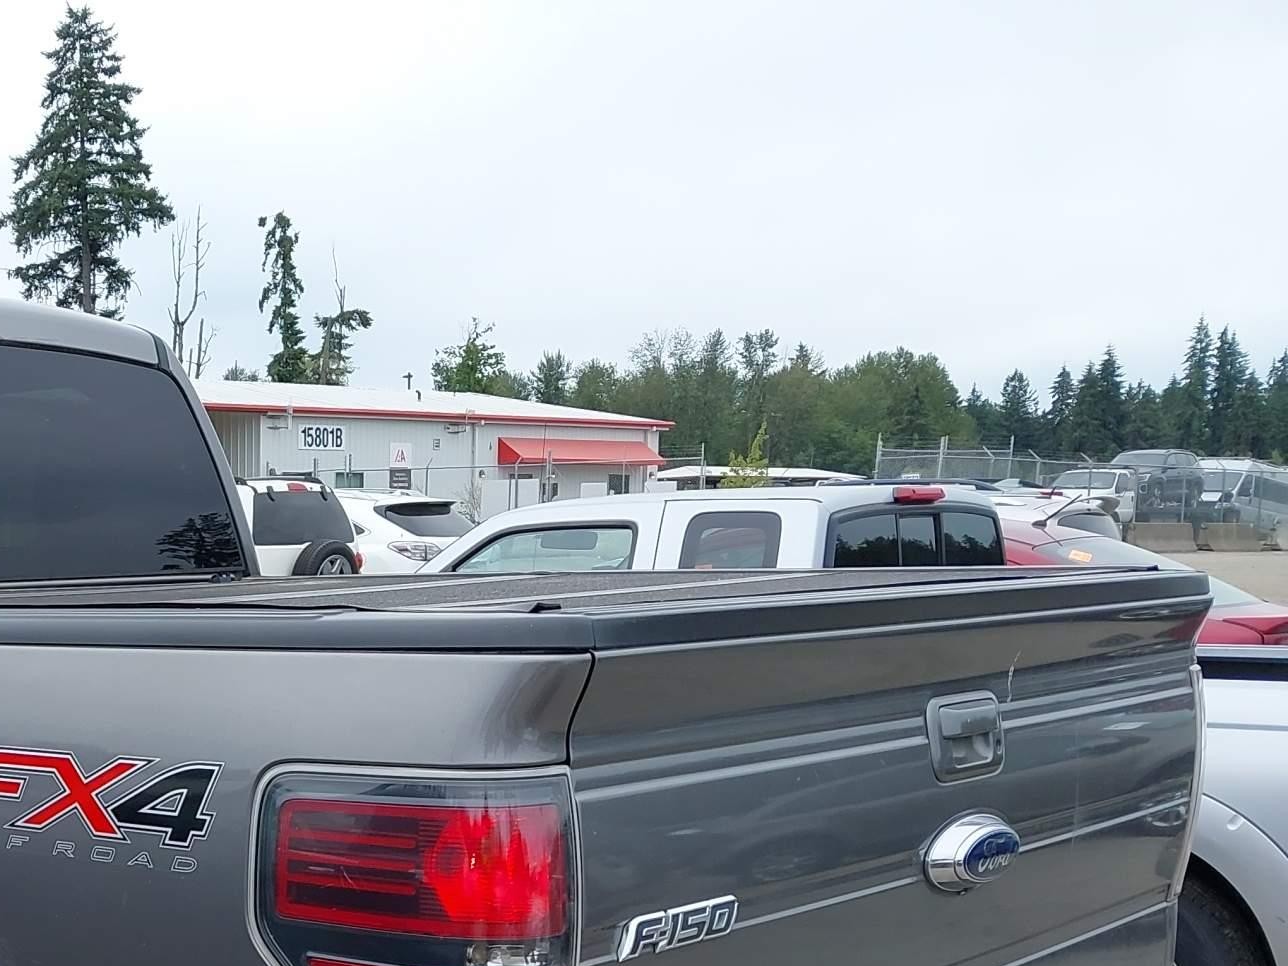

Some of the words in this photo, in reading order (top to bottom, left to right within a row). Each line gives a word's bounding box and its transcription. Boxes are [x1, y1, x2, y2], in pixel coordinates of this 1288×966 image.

[301, 427, 343, 448] 15801B
[52, 840, 198, 873] ROAD
[977, 834, 1016, 874] Ford
[617, 894, 739, 963] F-150
